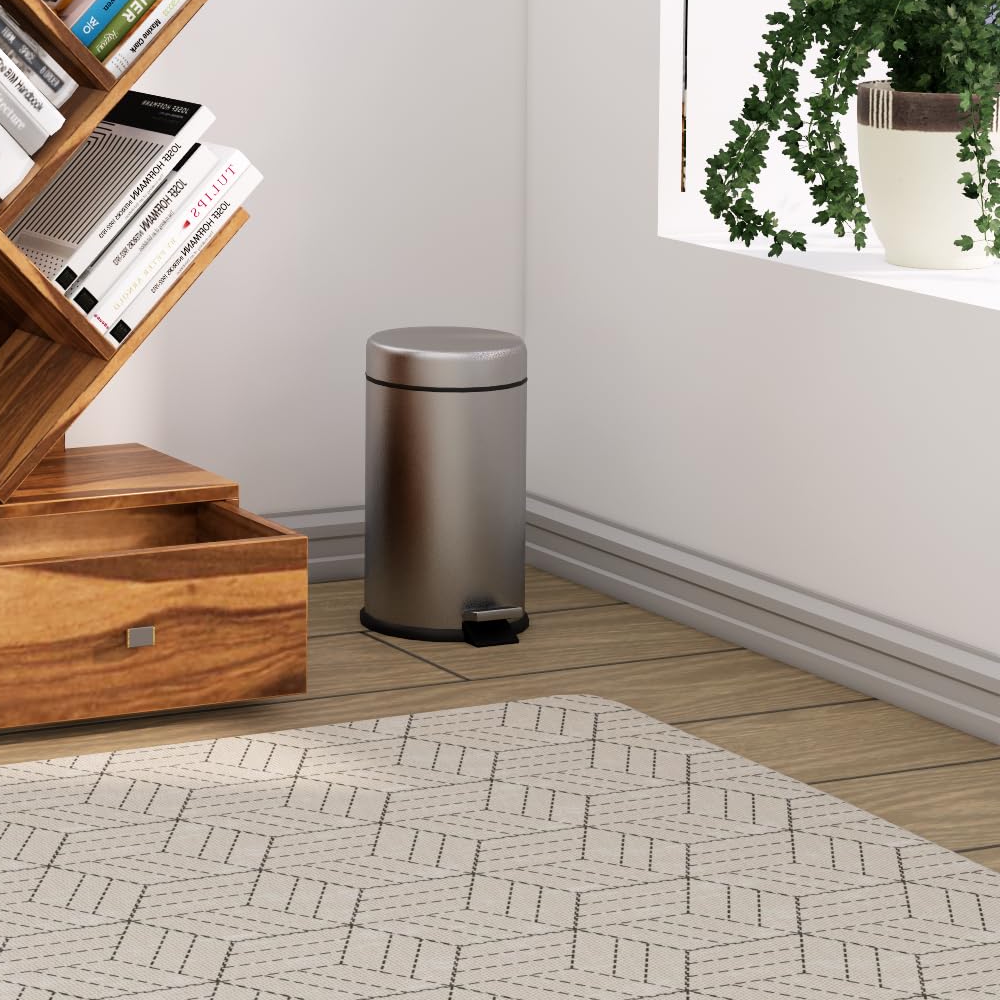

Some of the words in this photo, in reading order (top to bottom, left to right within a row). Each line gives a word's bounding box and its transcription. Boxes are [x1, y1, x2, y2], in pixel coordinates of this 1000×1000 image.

[143, 19, 161, 38] Maxine
[130, 38, 144, 53] Clark
[4, 68, 18, 83] BIM
[14, 80, 43, 112] Handbook
